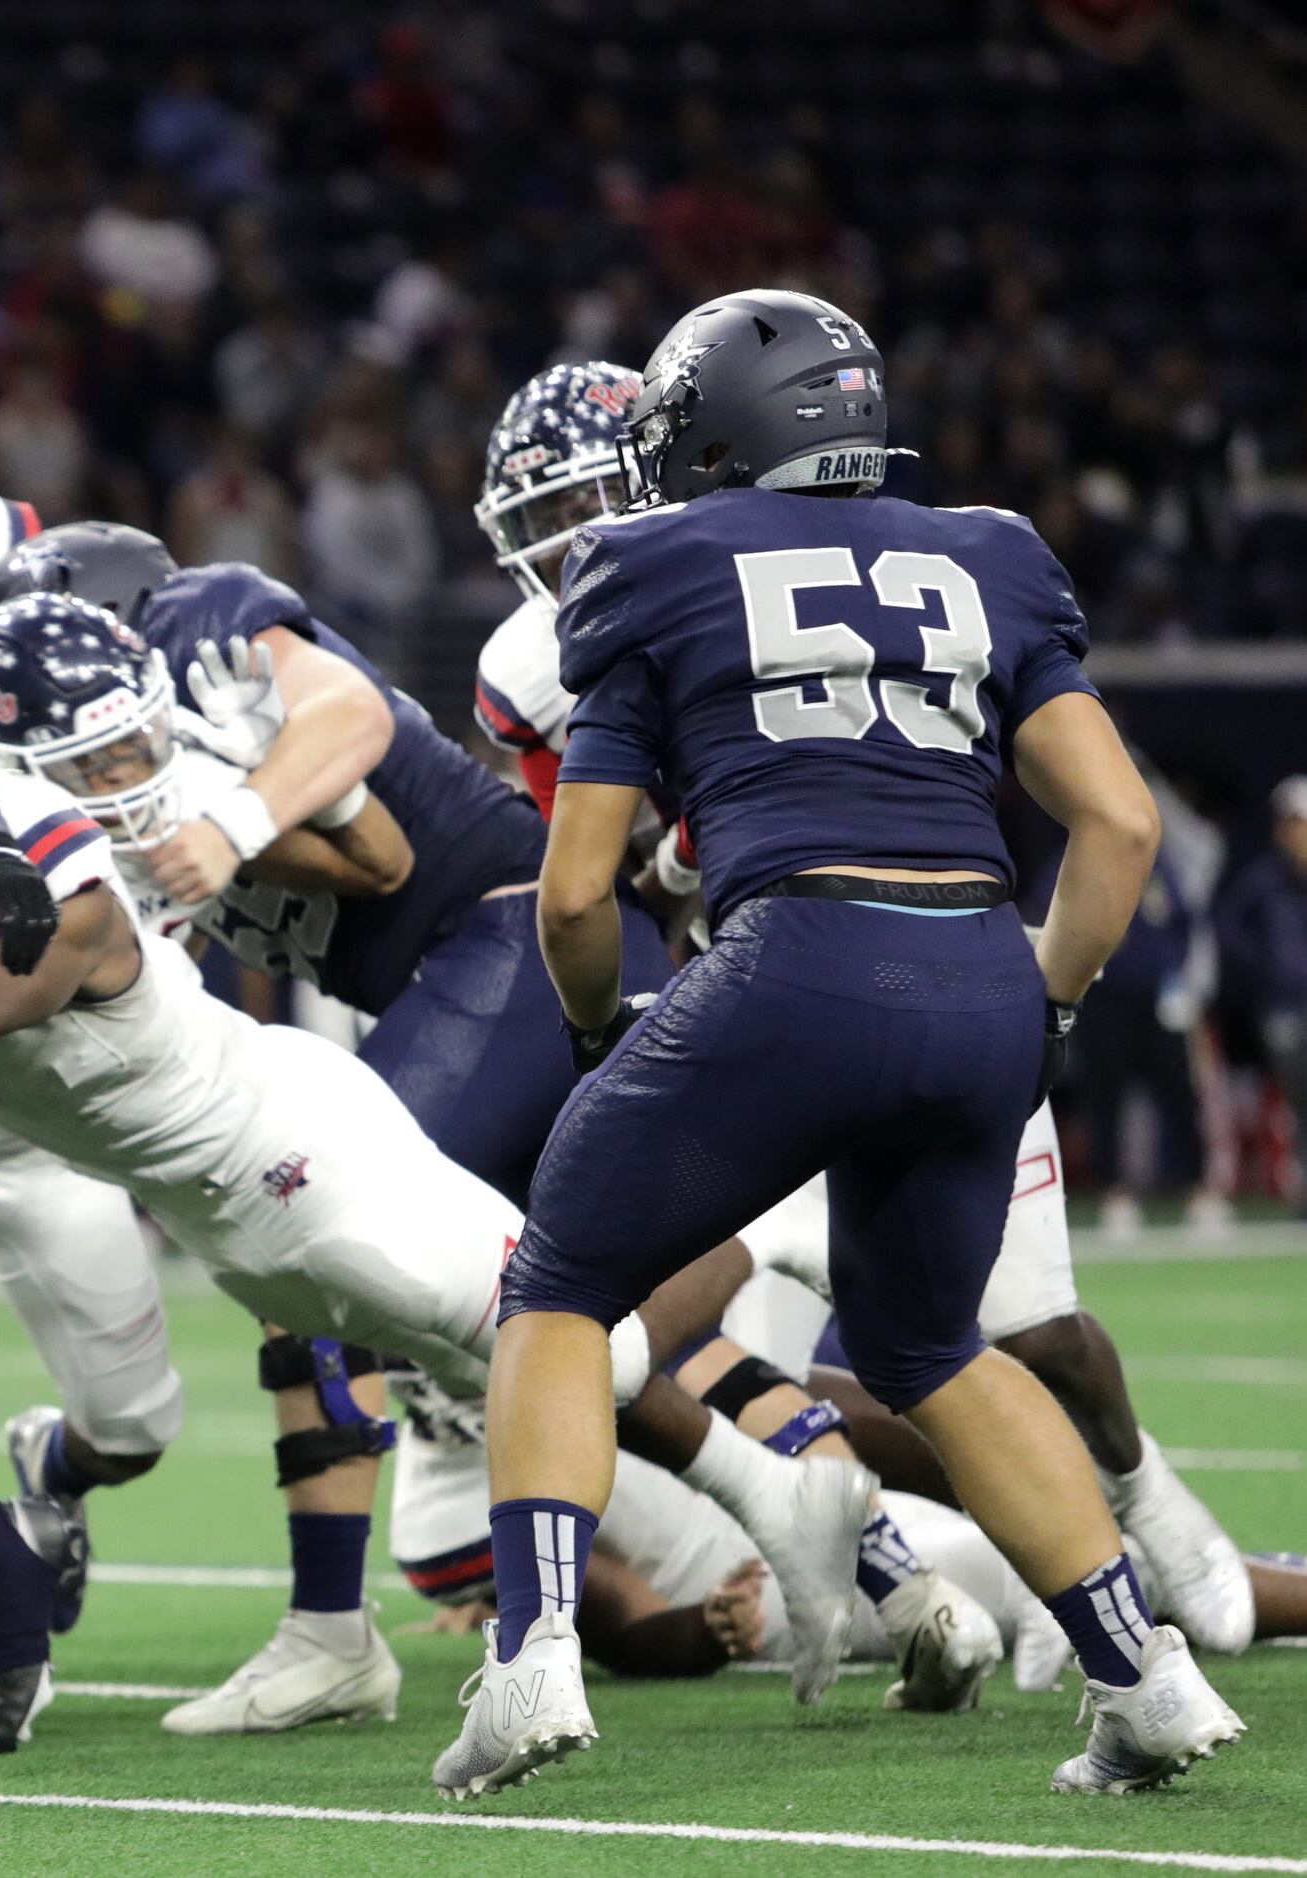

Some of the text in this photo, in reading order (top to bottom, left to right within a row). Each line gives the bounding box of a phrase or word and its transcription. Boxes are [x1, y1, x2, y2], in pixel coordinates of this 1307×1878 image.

[815, 315, 875, 350] 53
[733, 546, 993, 755] 53
[874, 881, 991, 901] FRUITOM
[502, 1668, 545, 1731] N
